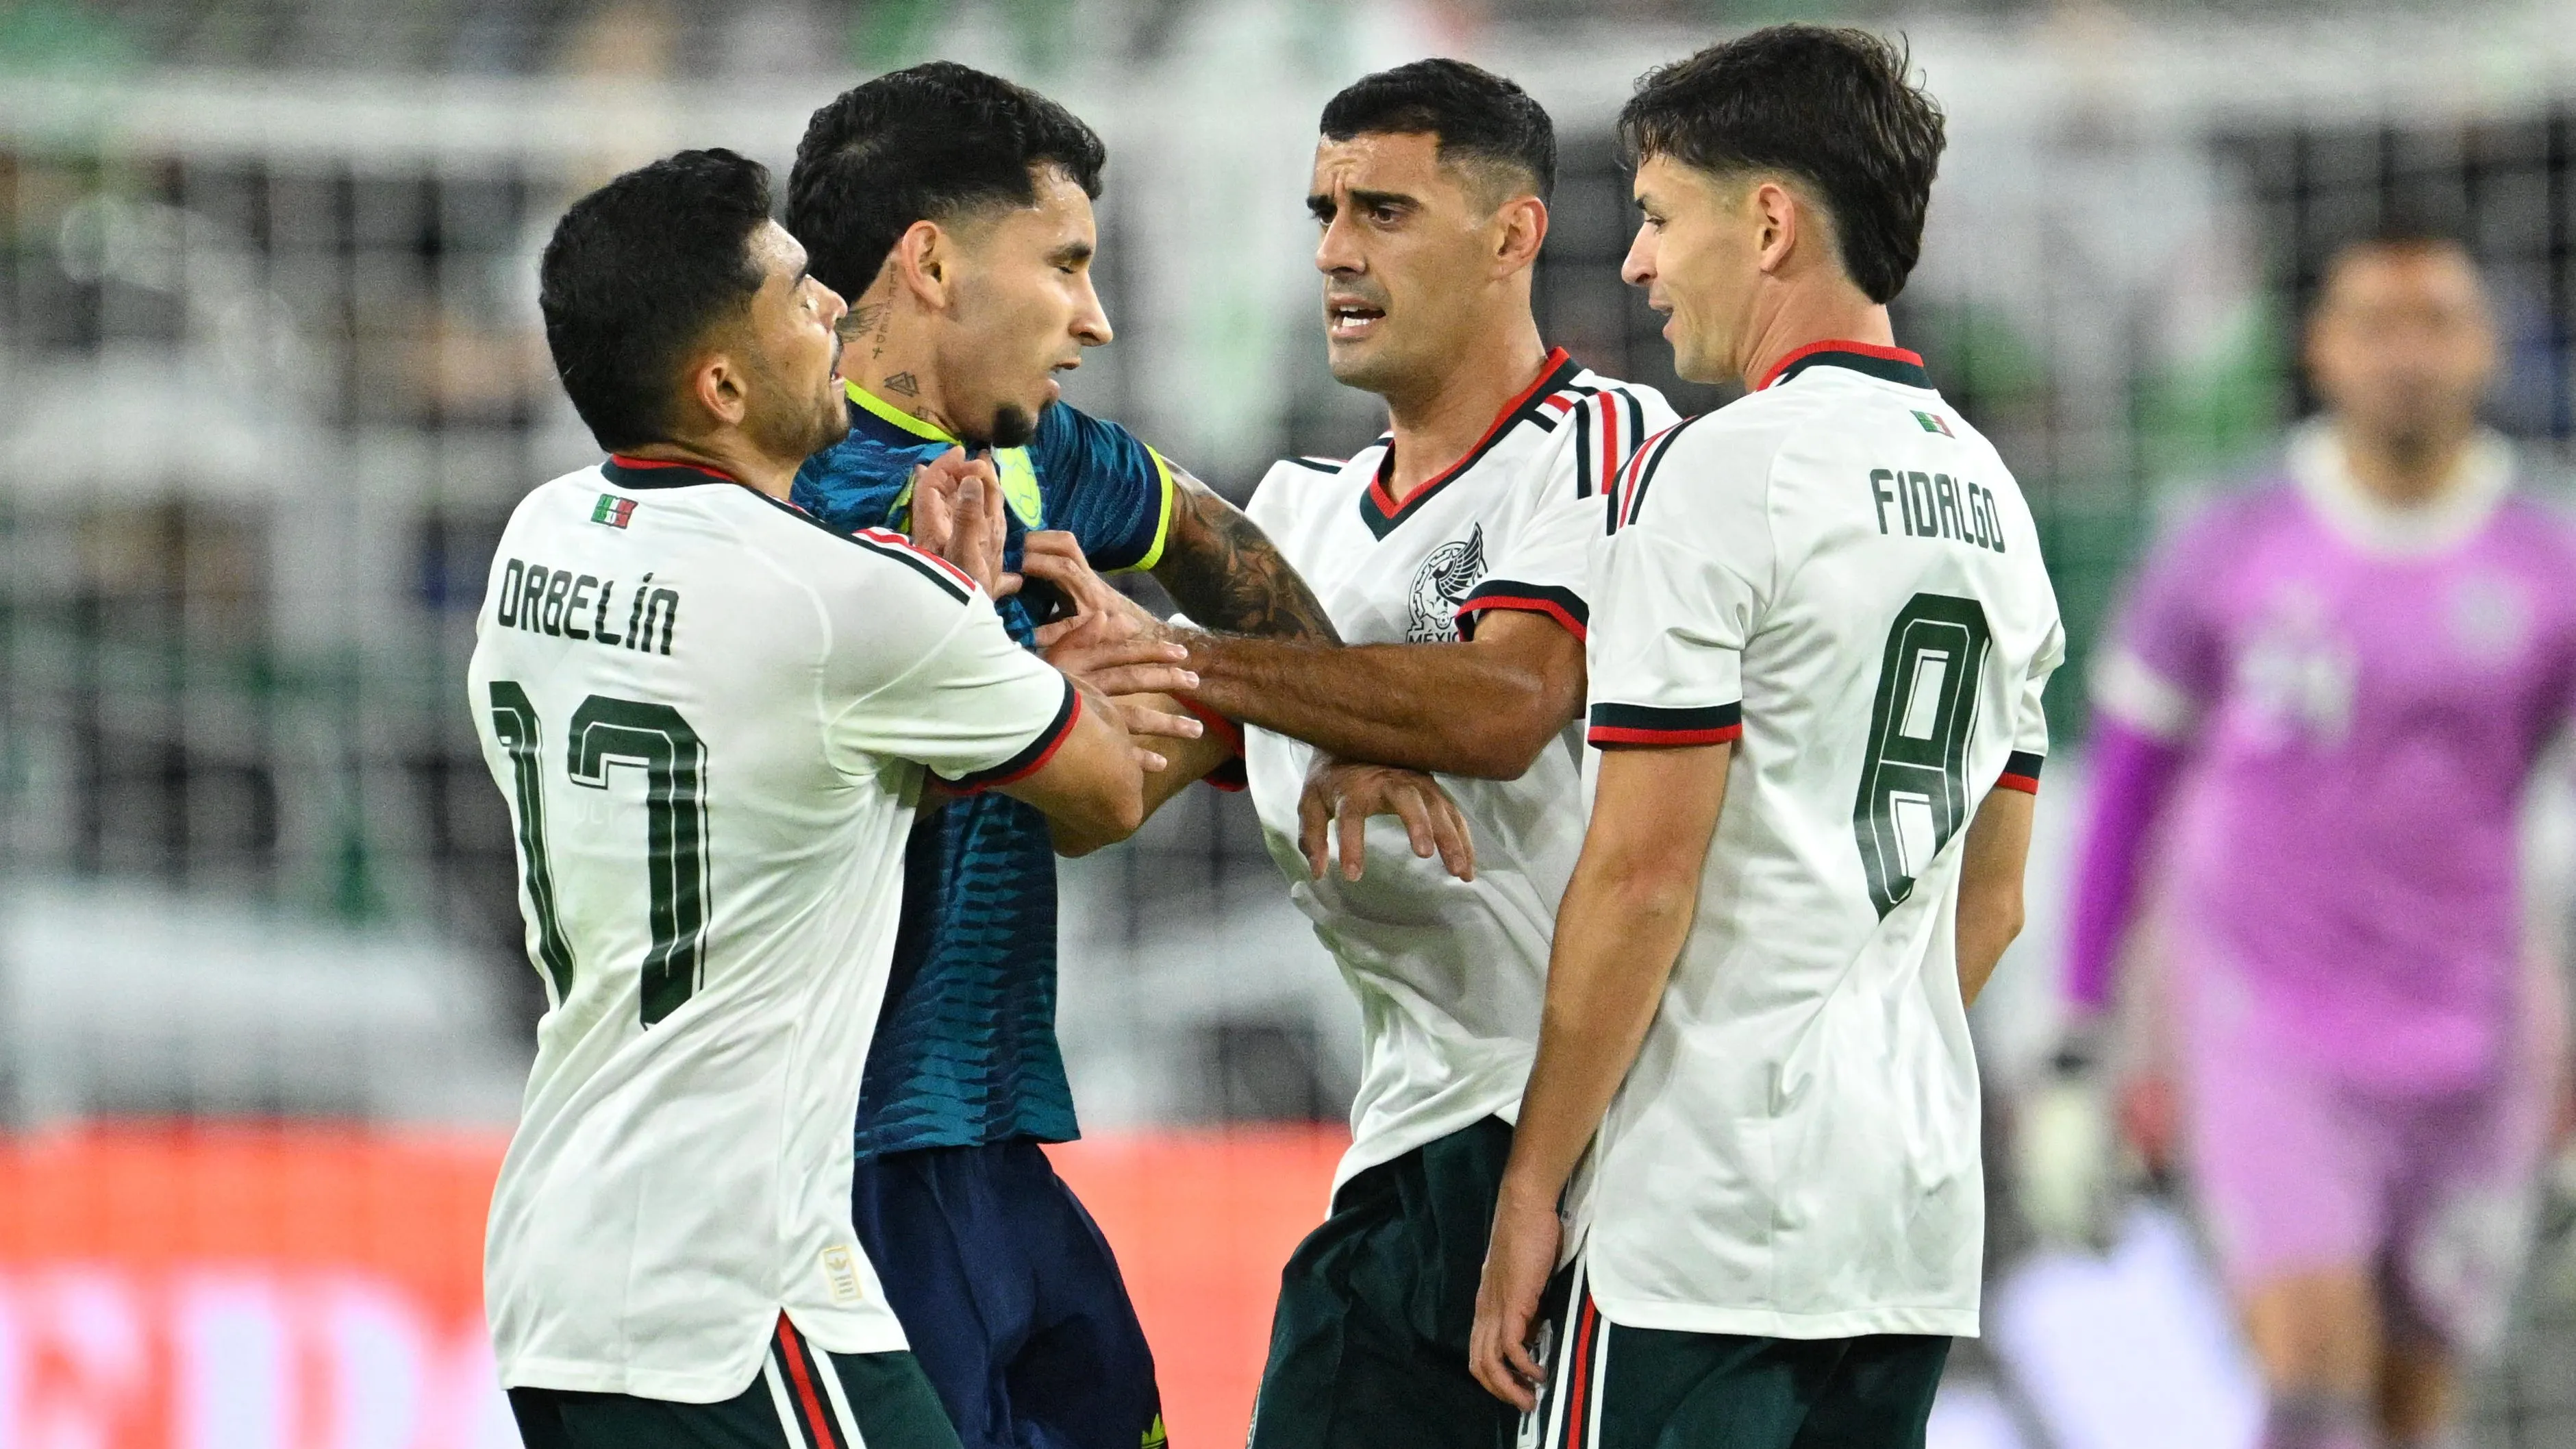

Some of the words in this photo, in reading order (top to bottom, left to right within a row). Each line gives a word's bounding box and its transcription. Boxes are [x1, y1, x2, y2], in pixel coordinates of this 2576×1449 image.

[1869, 469, 2006, 554] FIDALGO
[488, 680, 711, 1031] 17
[1853, 592, 1993, 926] 8
